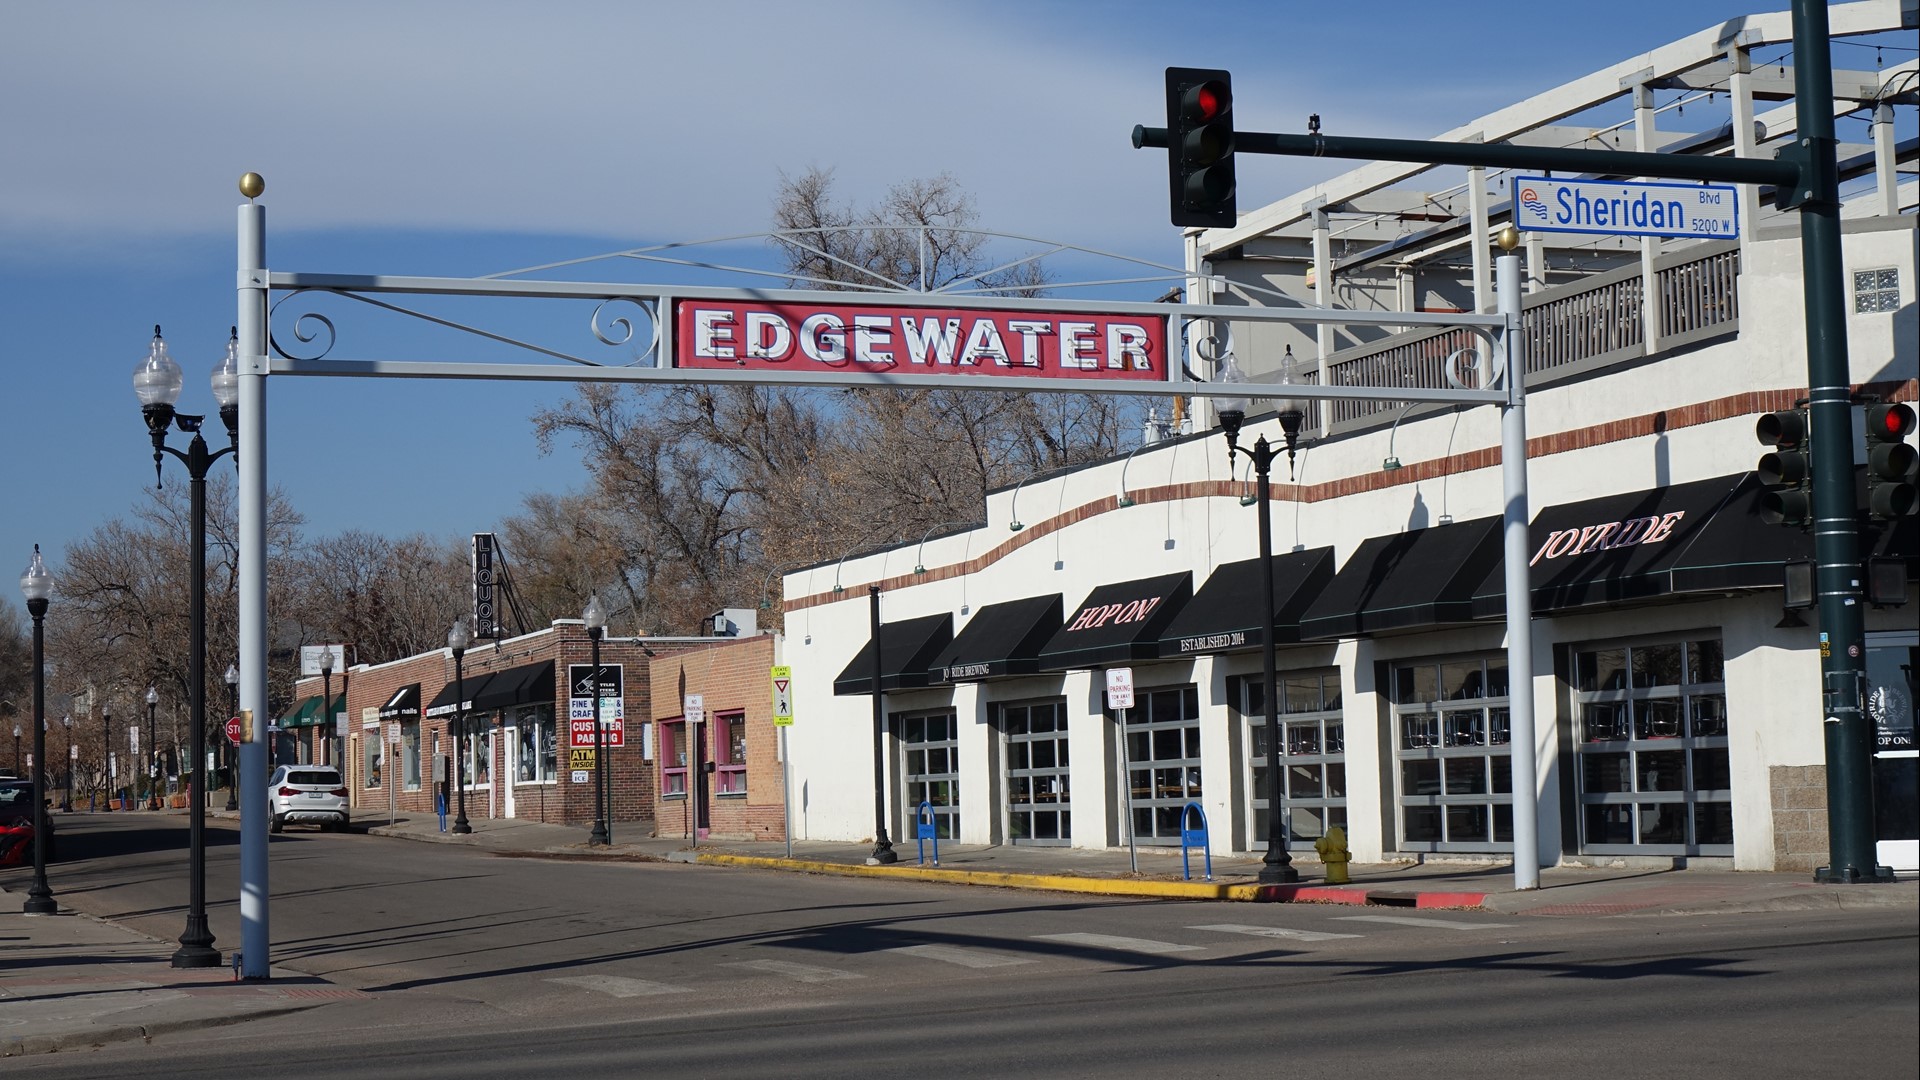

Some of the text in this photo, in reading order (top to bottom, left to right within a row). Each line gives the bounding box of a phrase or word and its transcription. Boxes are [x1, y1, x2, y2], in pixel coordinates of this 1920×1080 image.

[1699, 191, 1720, 205] Blvd
[1556, 186, 1684, 228] Sheridan
[1692, 218, 1730, 233] 5200 W
[693, 308, 1153, 371] EDGEWATER
[1529, 510, 1685, 568] JOYRIDE
[478, 537, 492, 634] LIQUOR
[1066, 596, 1161, 632] HOP ON!
[1180, 631, 1245, 652] ESTABLISHED 2014
[965, 663, 990, 677] BREWING
[1115, 675, 1124, 683] NO
[1109, 684, 1131, 692] PARKING
[401, 707, 418, 715] nails
[572, 700, 588, 708] FINE
[572, 721, 622, 732] CUSTER
[576, 733, 618, 744] PARIG
[571, 749, 595, 760] ATM
